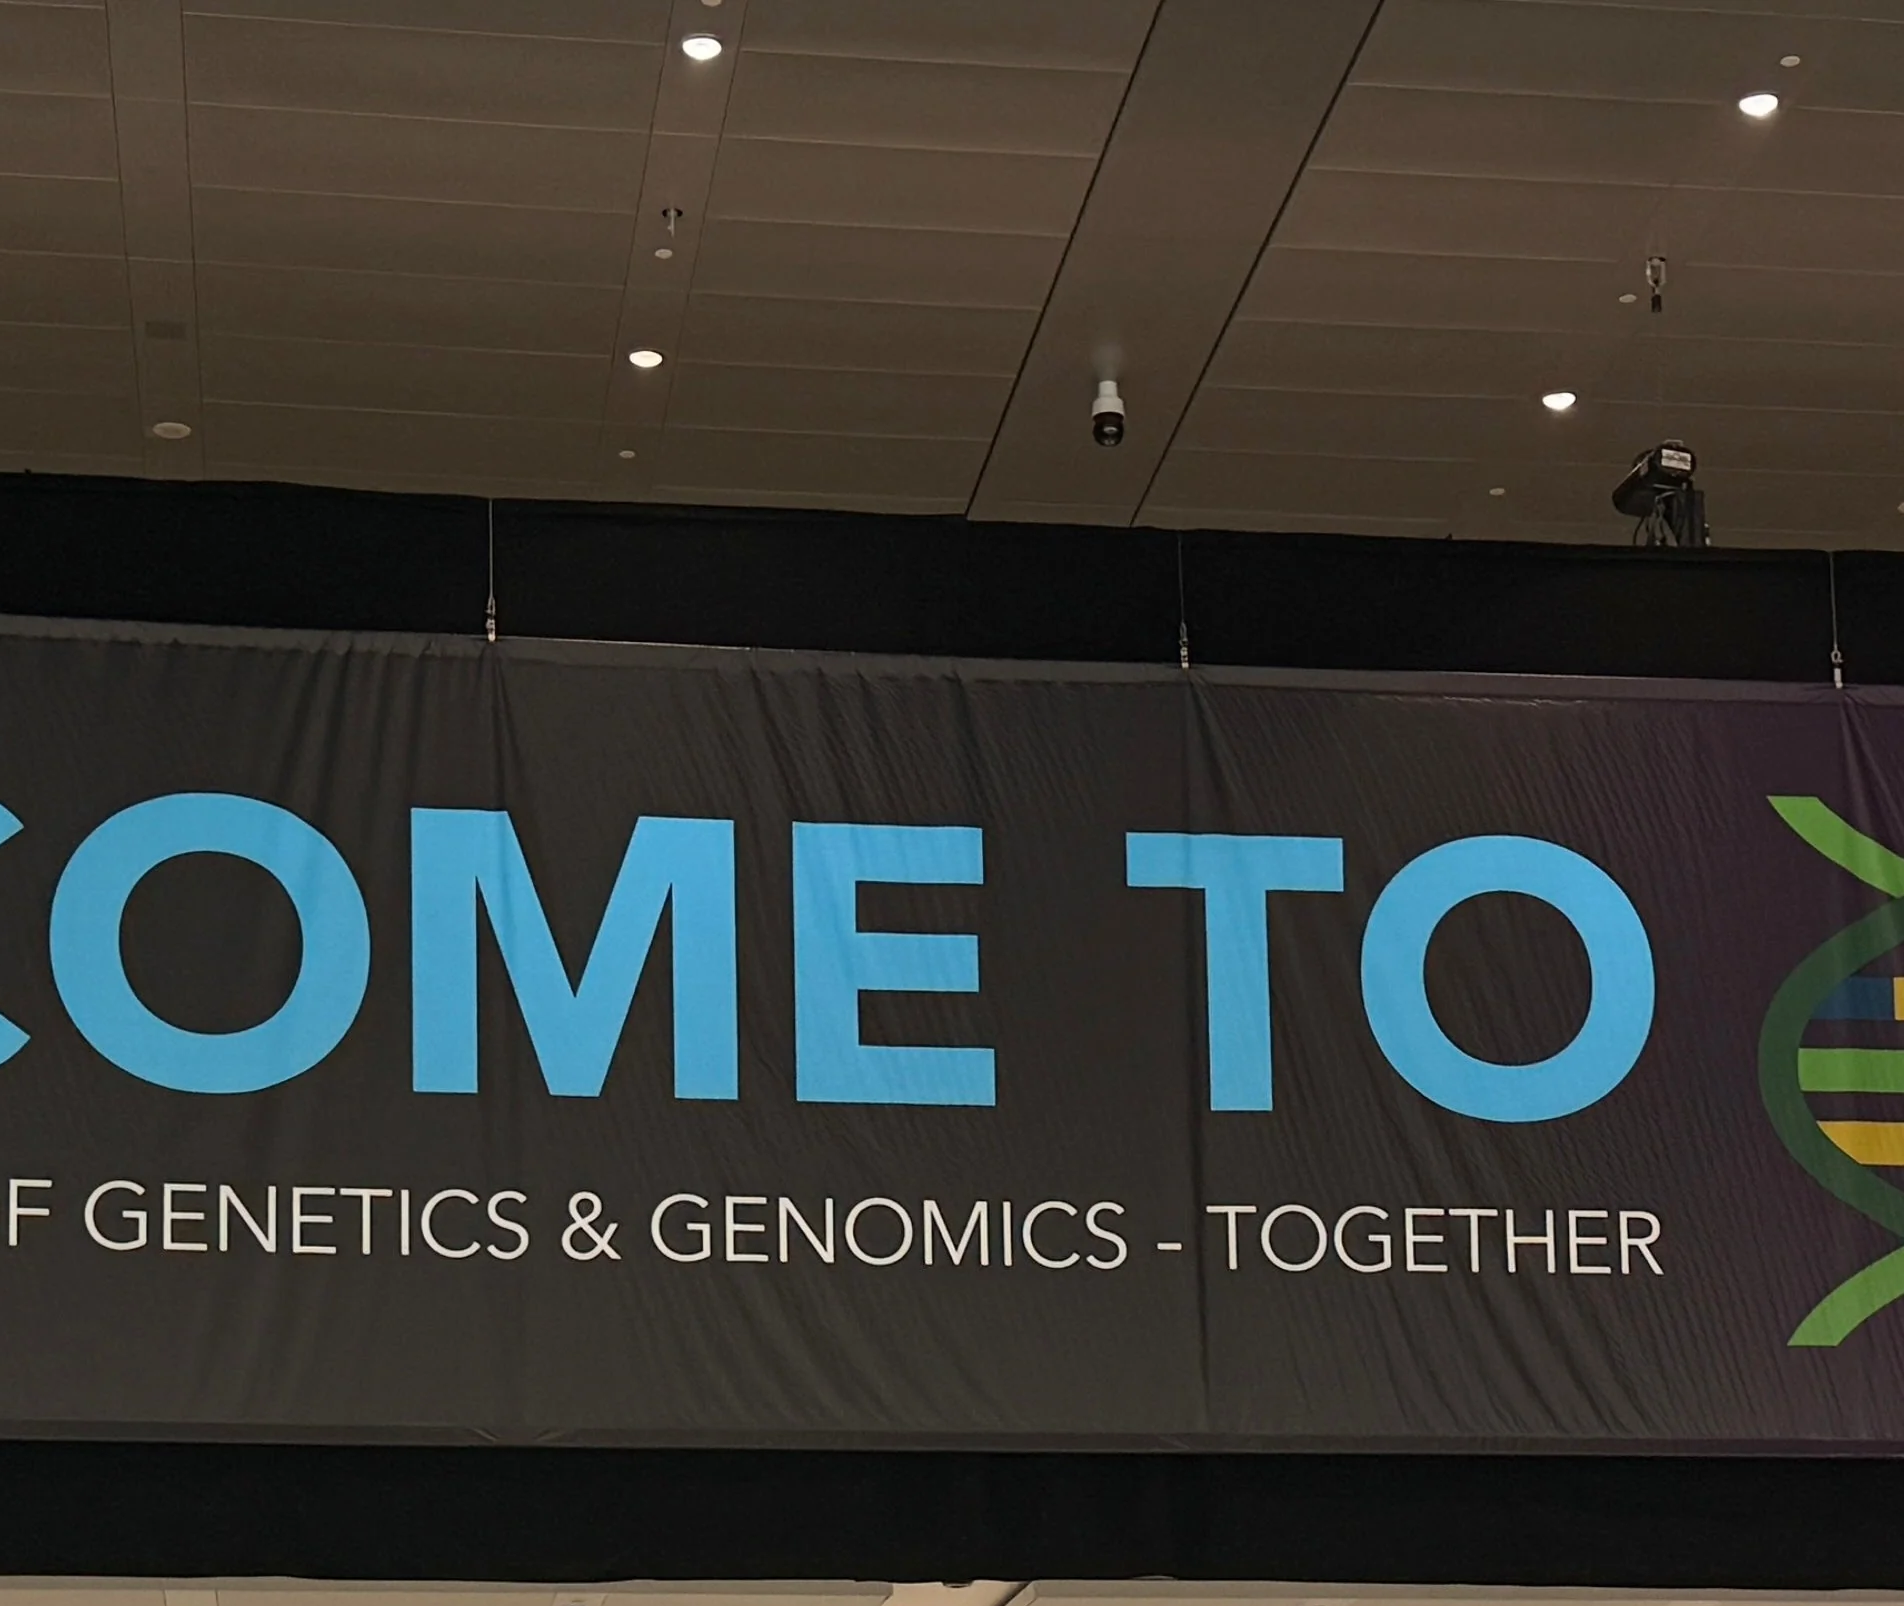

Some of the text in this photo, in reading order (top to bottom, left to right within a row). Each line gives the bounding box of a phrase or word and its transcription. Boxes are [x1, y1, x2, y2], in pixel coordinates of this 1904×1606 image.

[1126, 832, 1655, 1122] TO
[83, 1179, 530, 1259] GENETICS
[559, 1190, 622, 1261] &
[650, 1193, 1128, 1271] GENOMICS
[1157, 1240, 1183, 1251] -
[1206, 1203, 1665, 1275] TOGETHER
